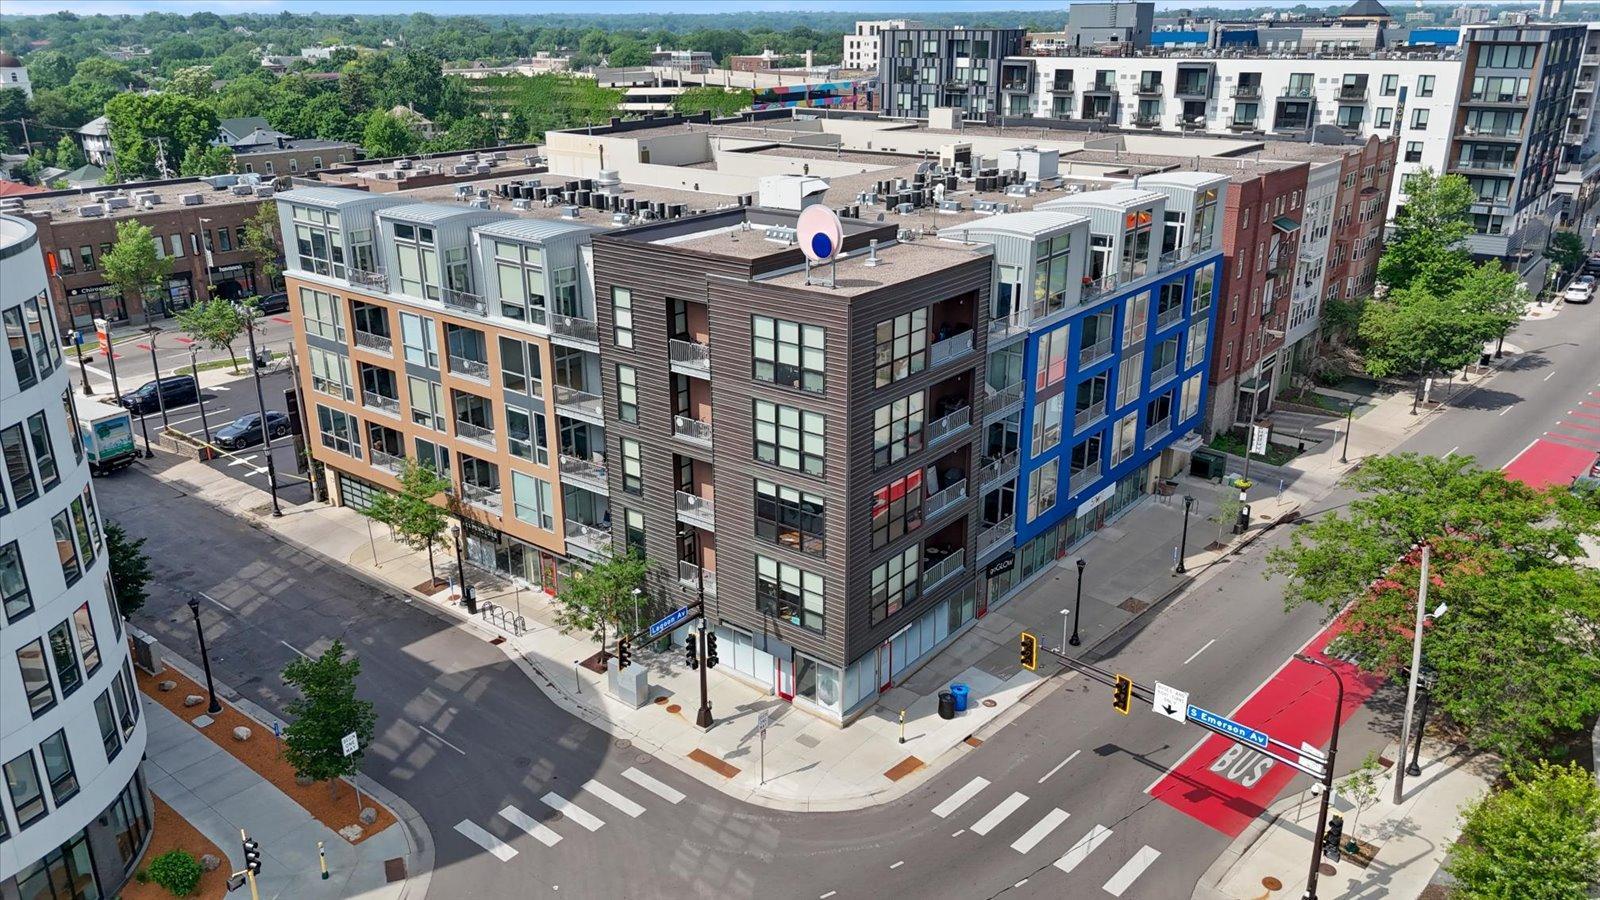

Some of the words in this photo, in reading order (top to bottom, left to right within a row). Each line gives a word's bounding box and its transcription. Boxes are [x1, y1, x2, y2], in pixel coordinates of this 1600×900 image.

[652, 617, 676, 634] Lagoon
[677, 610, 687, 620] Av
[1190, 708, 1198, 717] S
[1201, 712, 1246, 736] Emerson
[1250, 732, 1265, 743] Av
[1210, 743, 1274, 787] BUS
